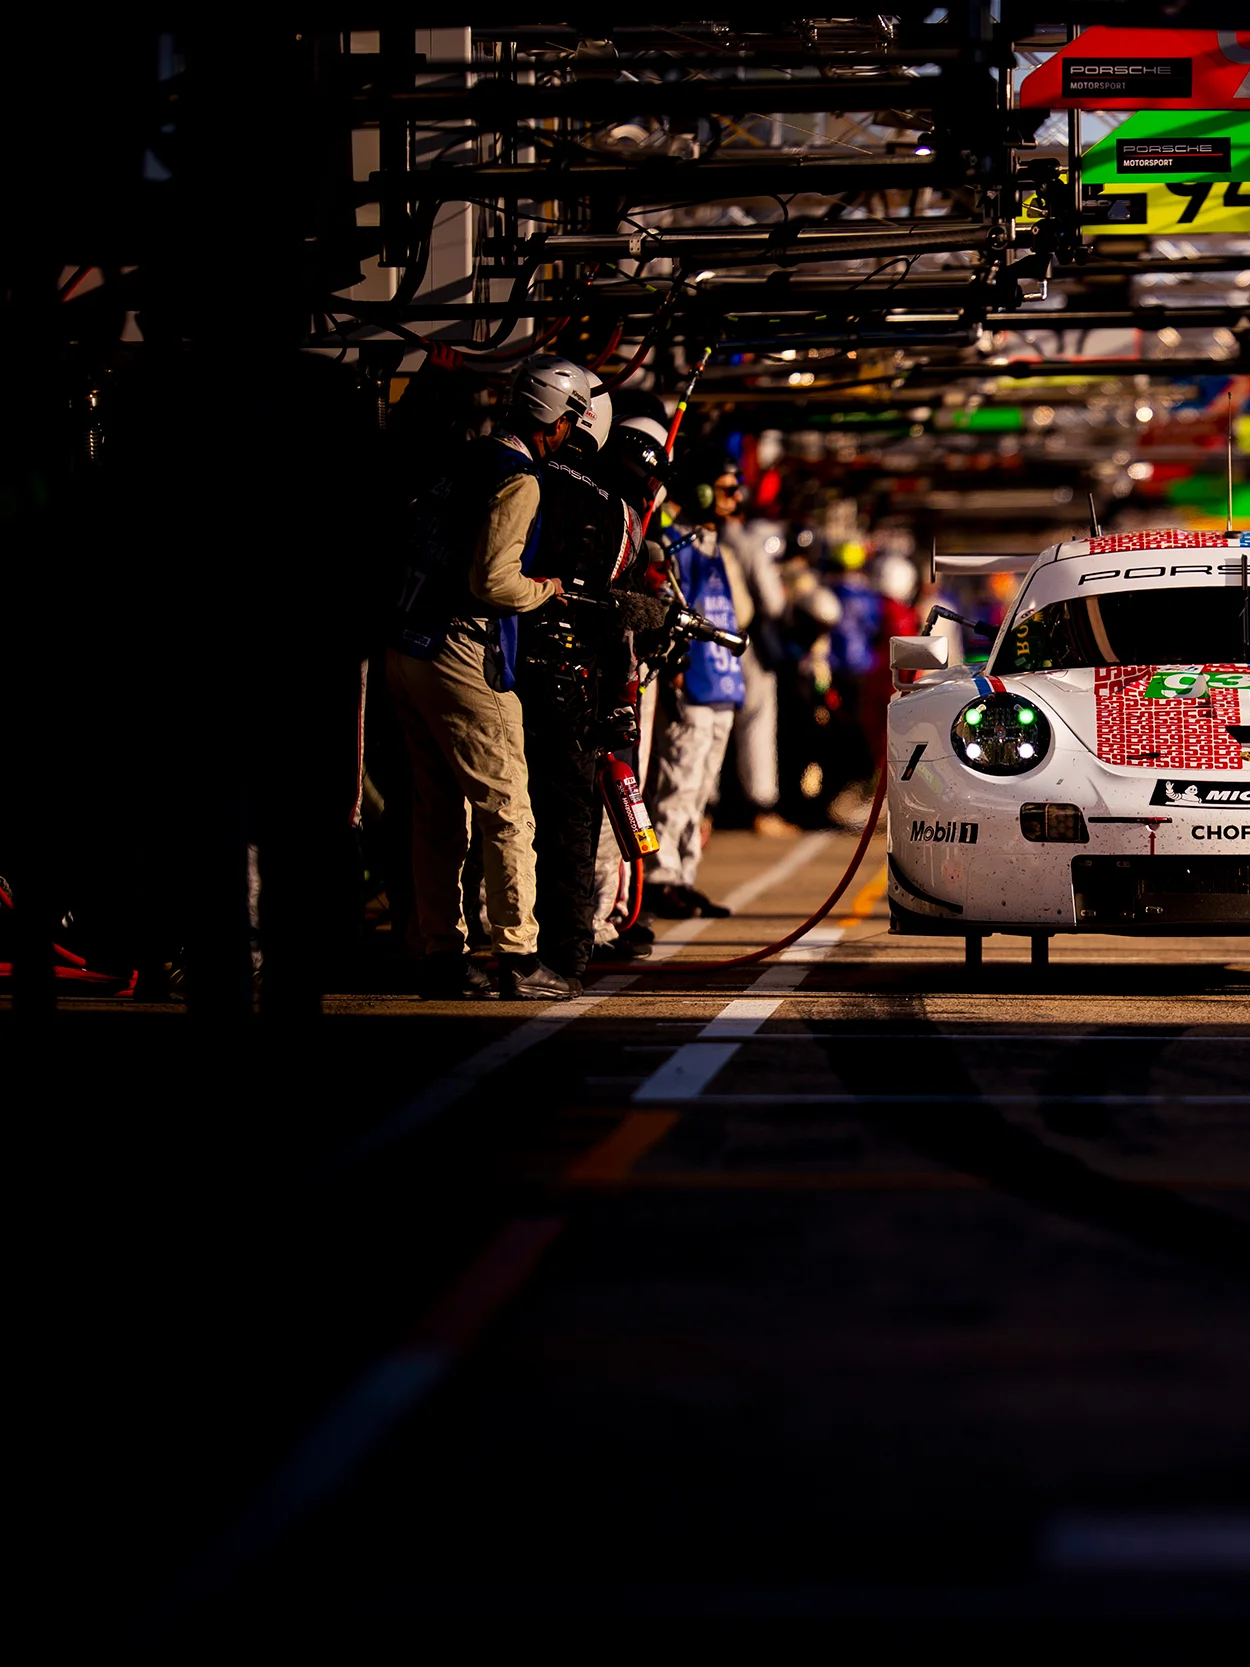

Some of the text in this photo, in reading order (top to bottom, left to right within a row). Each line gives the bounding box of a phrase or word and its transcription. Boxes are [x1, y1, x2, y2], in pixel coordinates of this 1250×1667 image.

[1070, 65, 1172, 75] PORSCHE
[1070, 81, 1127, 91] MOTORSPORT
[1122, 144, 1213, 153] PORSCHE
[1123, 158, 1174, 168] MOTORSPORT
[910, 820, 957, 843] Mobil
